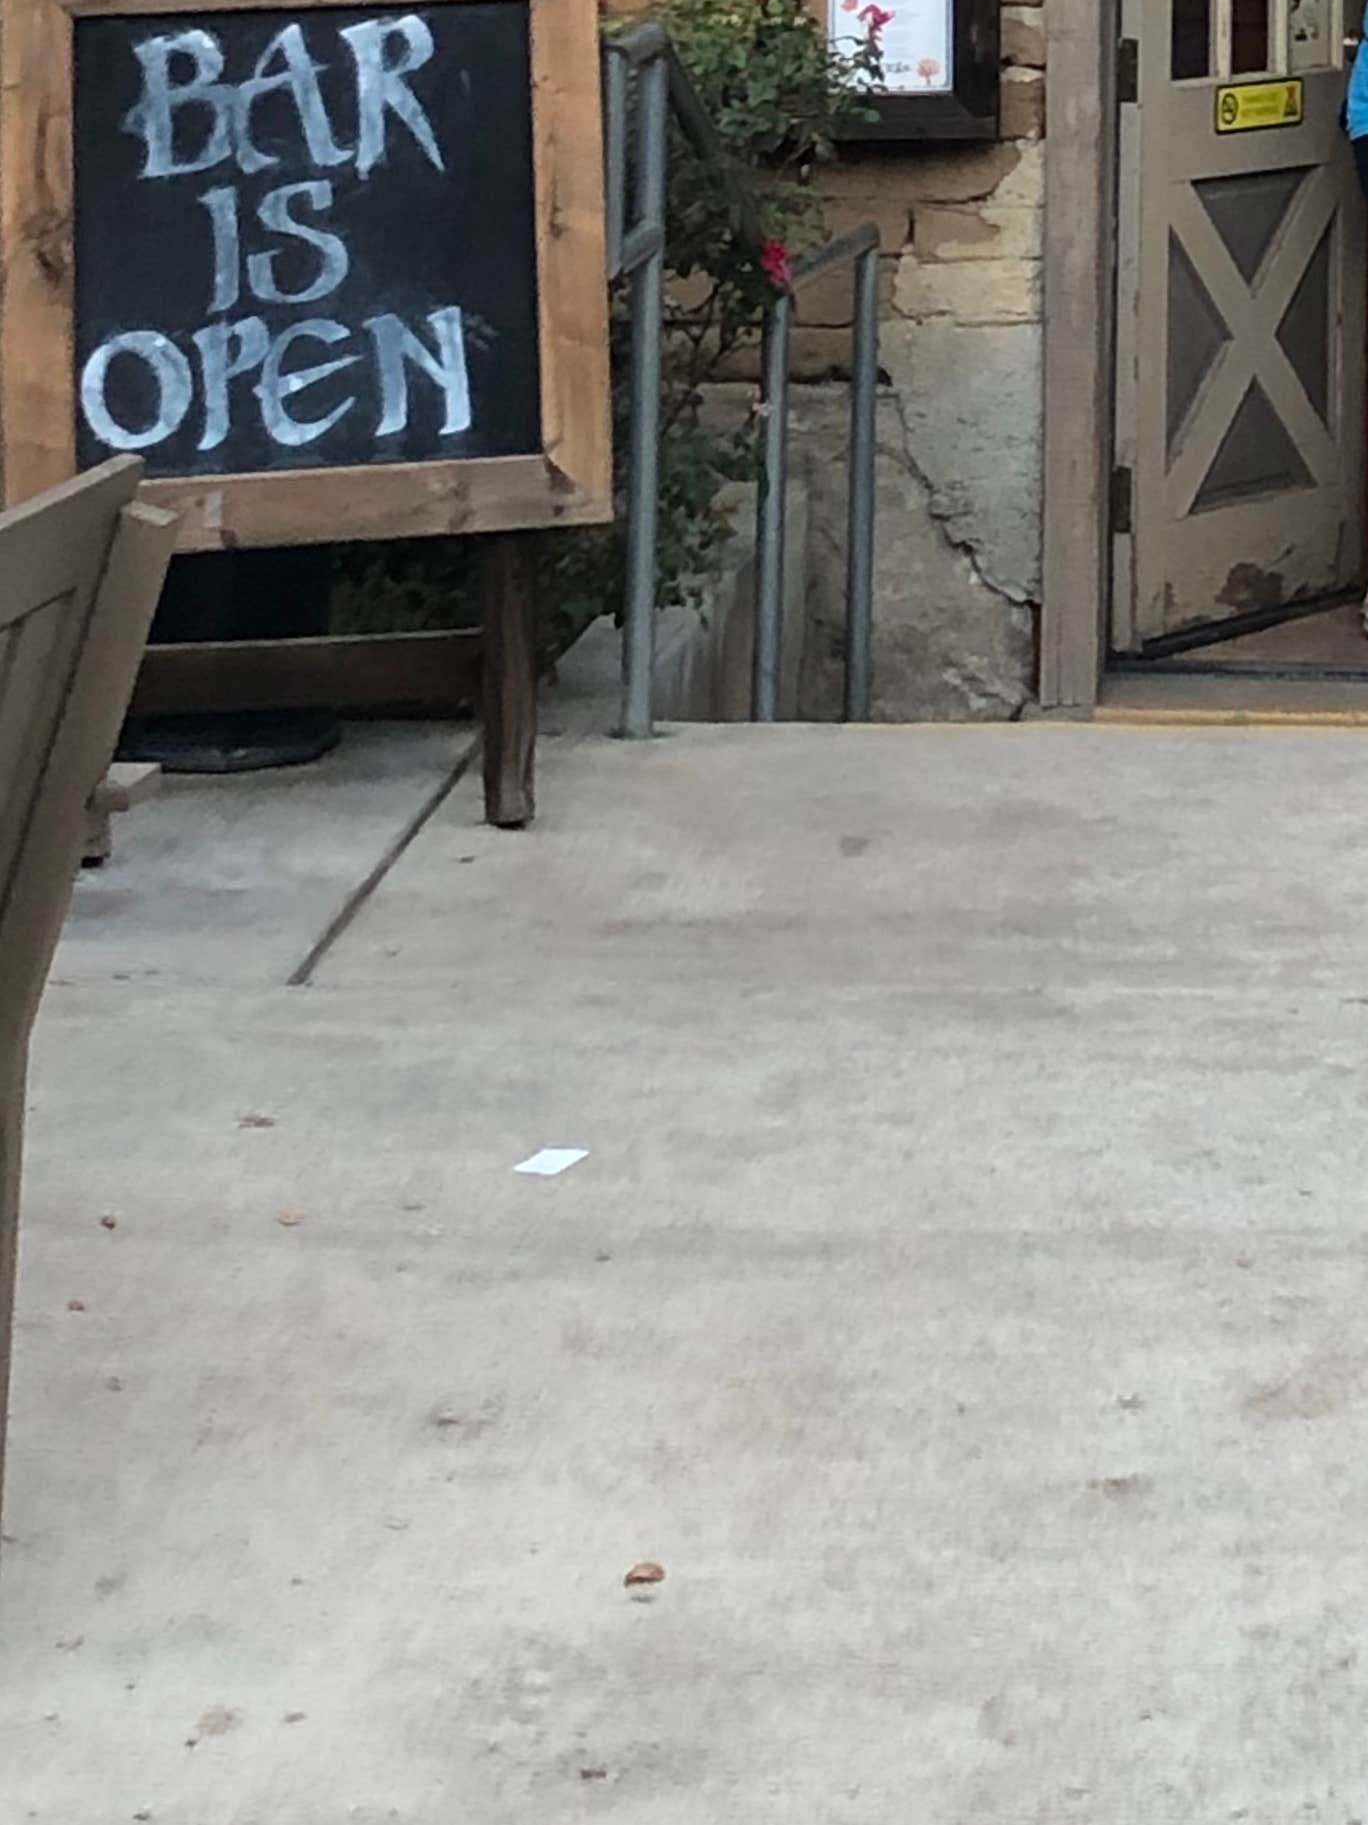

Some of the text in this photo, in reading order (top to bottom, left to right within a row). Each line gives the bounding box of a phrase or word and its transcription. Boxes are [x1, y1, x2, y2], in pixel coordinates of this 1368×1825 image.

[125, 14, 445, 180] BAR
[198, 179, 348, 313] IS
[81, 305, 472, 452] OPEN
